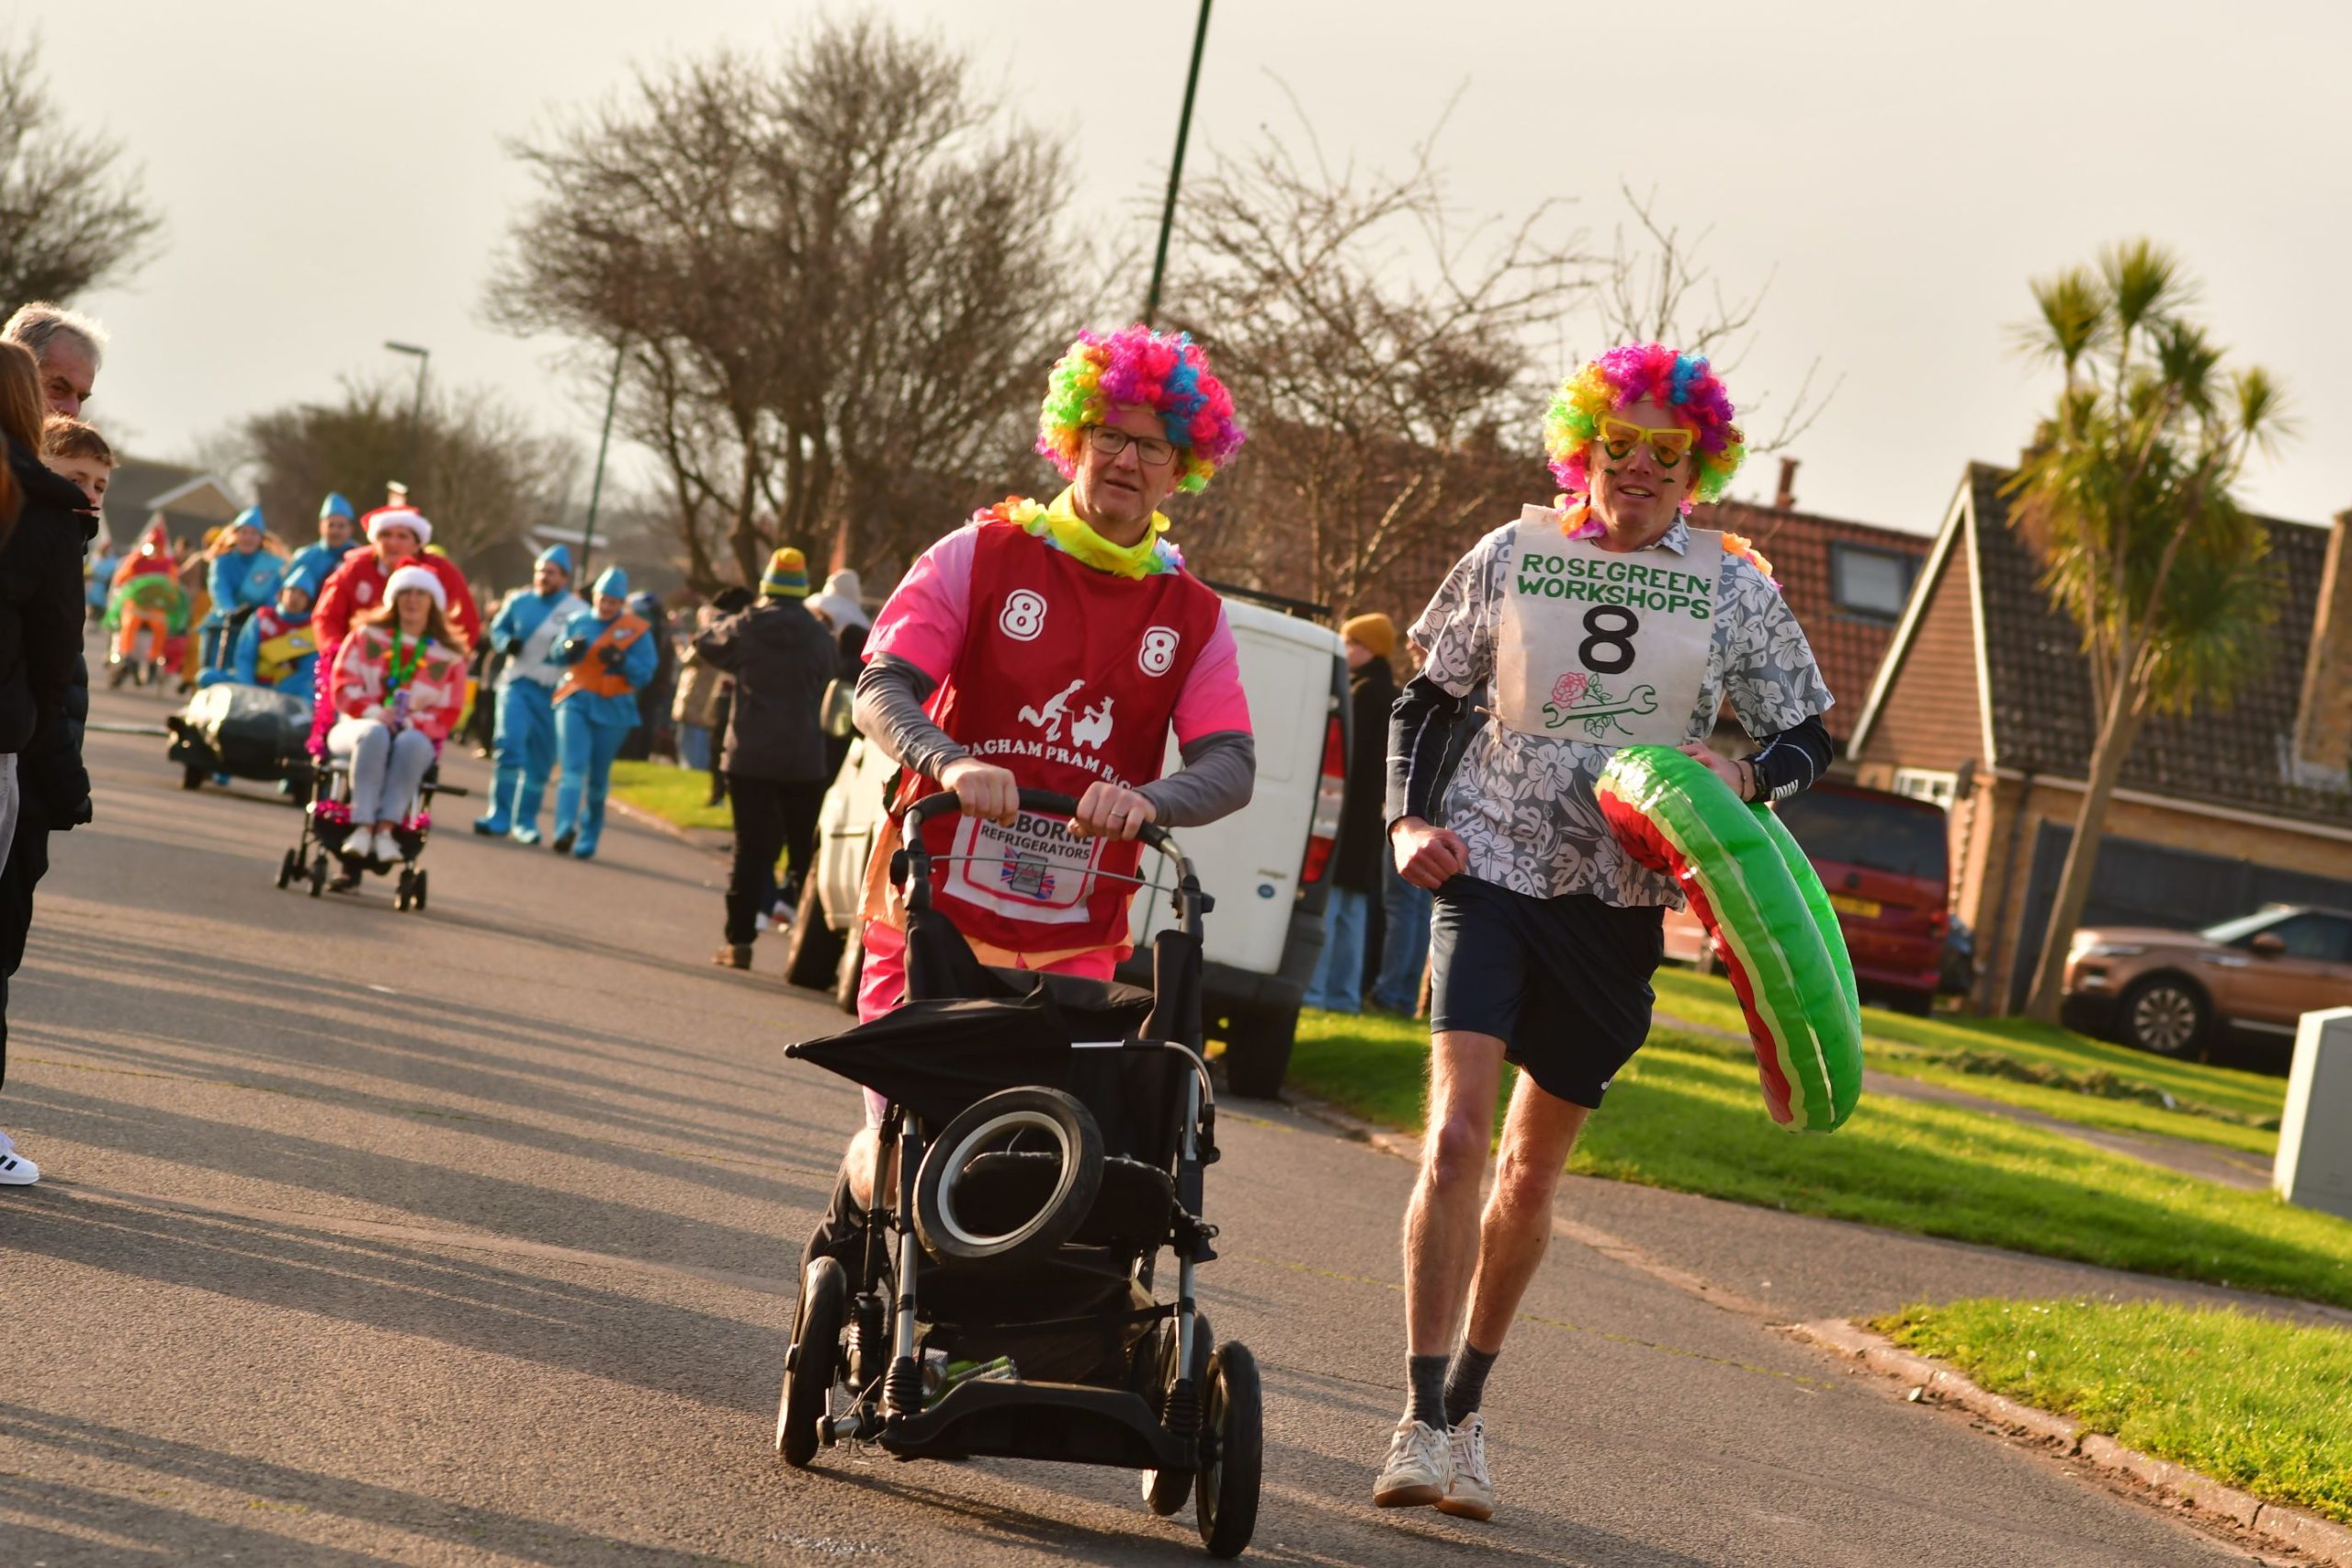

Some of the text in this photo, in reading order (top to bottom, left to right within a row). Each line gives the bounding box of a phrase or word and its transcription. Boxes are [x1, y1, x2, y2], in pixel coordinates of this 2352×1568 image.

[1521, 553, 1712, 596] ROSEGREEN
[1000, 589, 1047, 641] 8
[1517, 575, 1713, 619] WORKSHOPS
[1138, 626, 1180, 677] 8
[1578, 604, 1640, 674] 8
[1046, 747, 1100, 773] PRAM
[1101, 763, 1136, 791] RAC
[980, 825, 1091, 860] REFRIGERATORS
